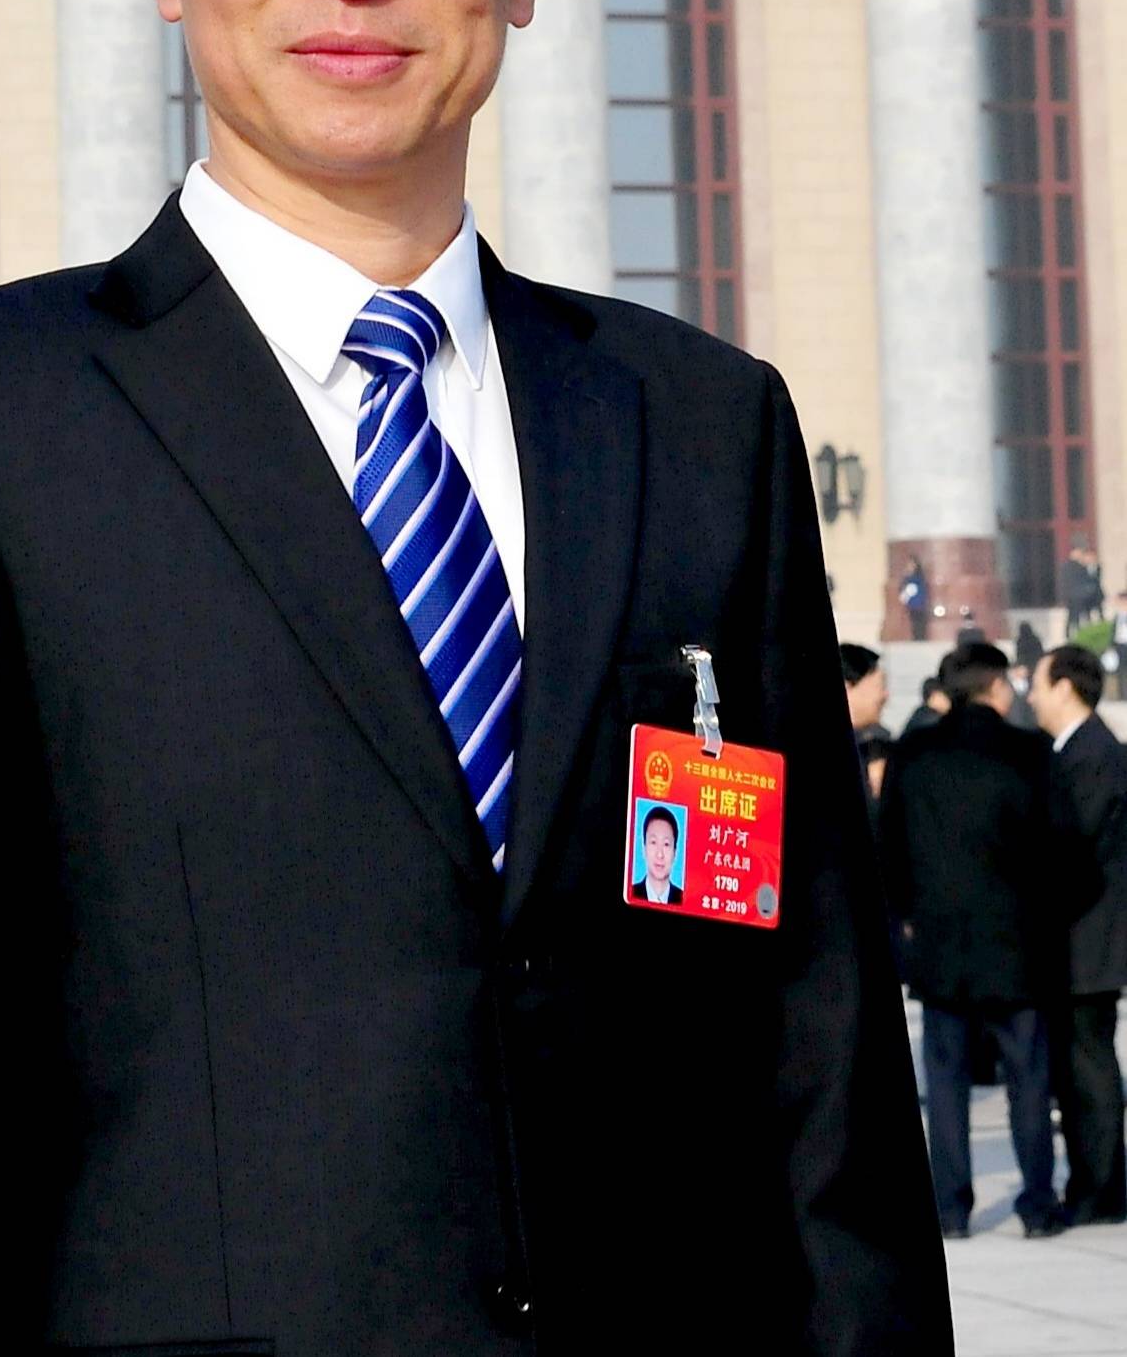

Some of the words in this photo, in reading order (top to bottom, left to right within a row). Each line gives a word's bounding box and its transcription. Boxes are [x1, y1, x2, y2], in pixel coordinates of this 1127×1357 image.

[700, 785, 757, 821] 出席证
[709, 824, 749, 849] 刘广河
[703, 849, 751, 871] 广东代表团
[714, 875, 739, 892] 1790
